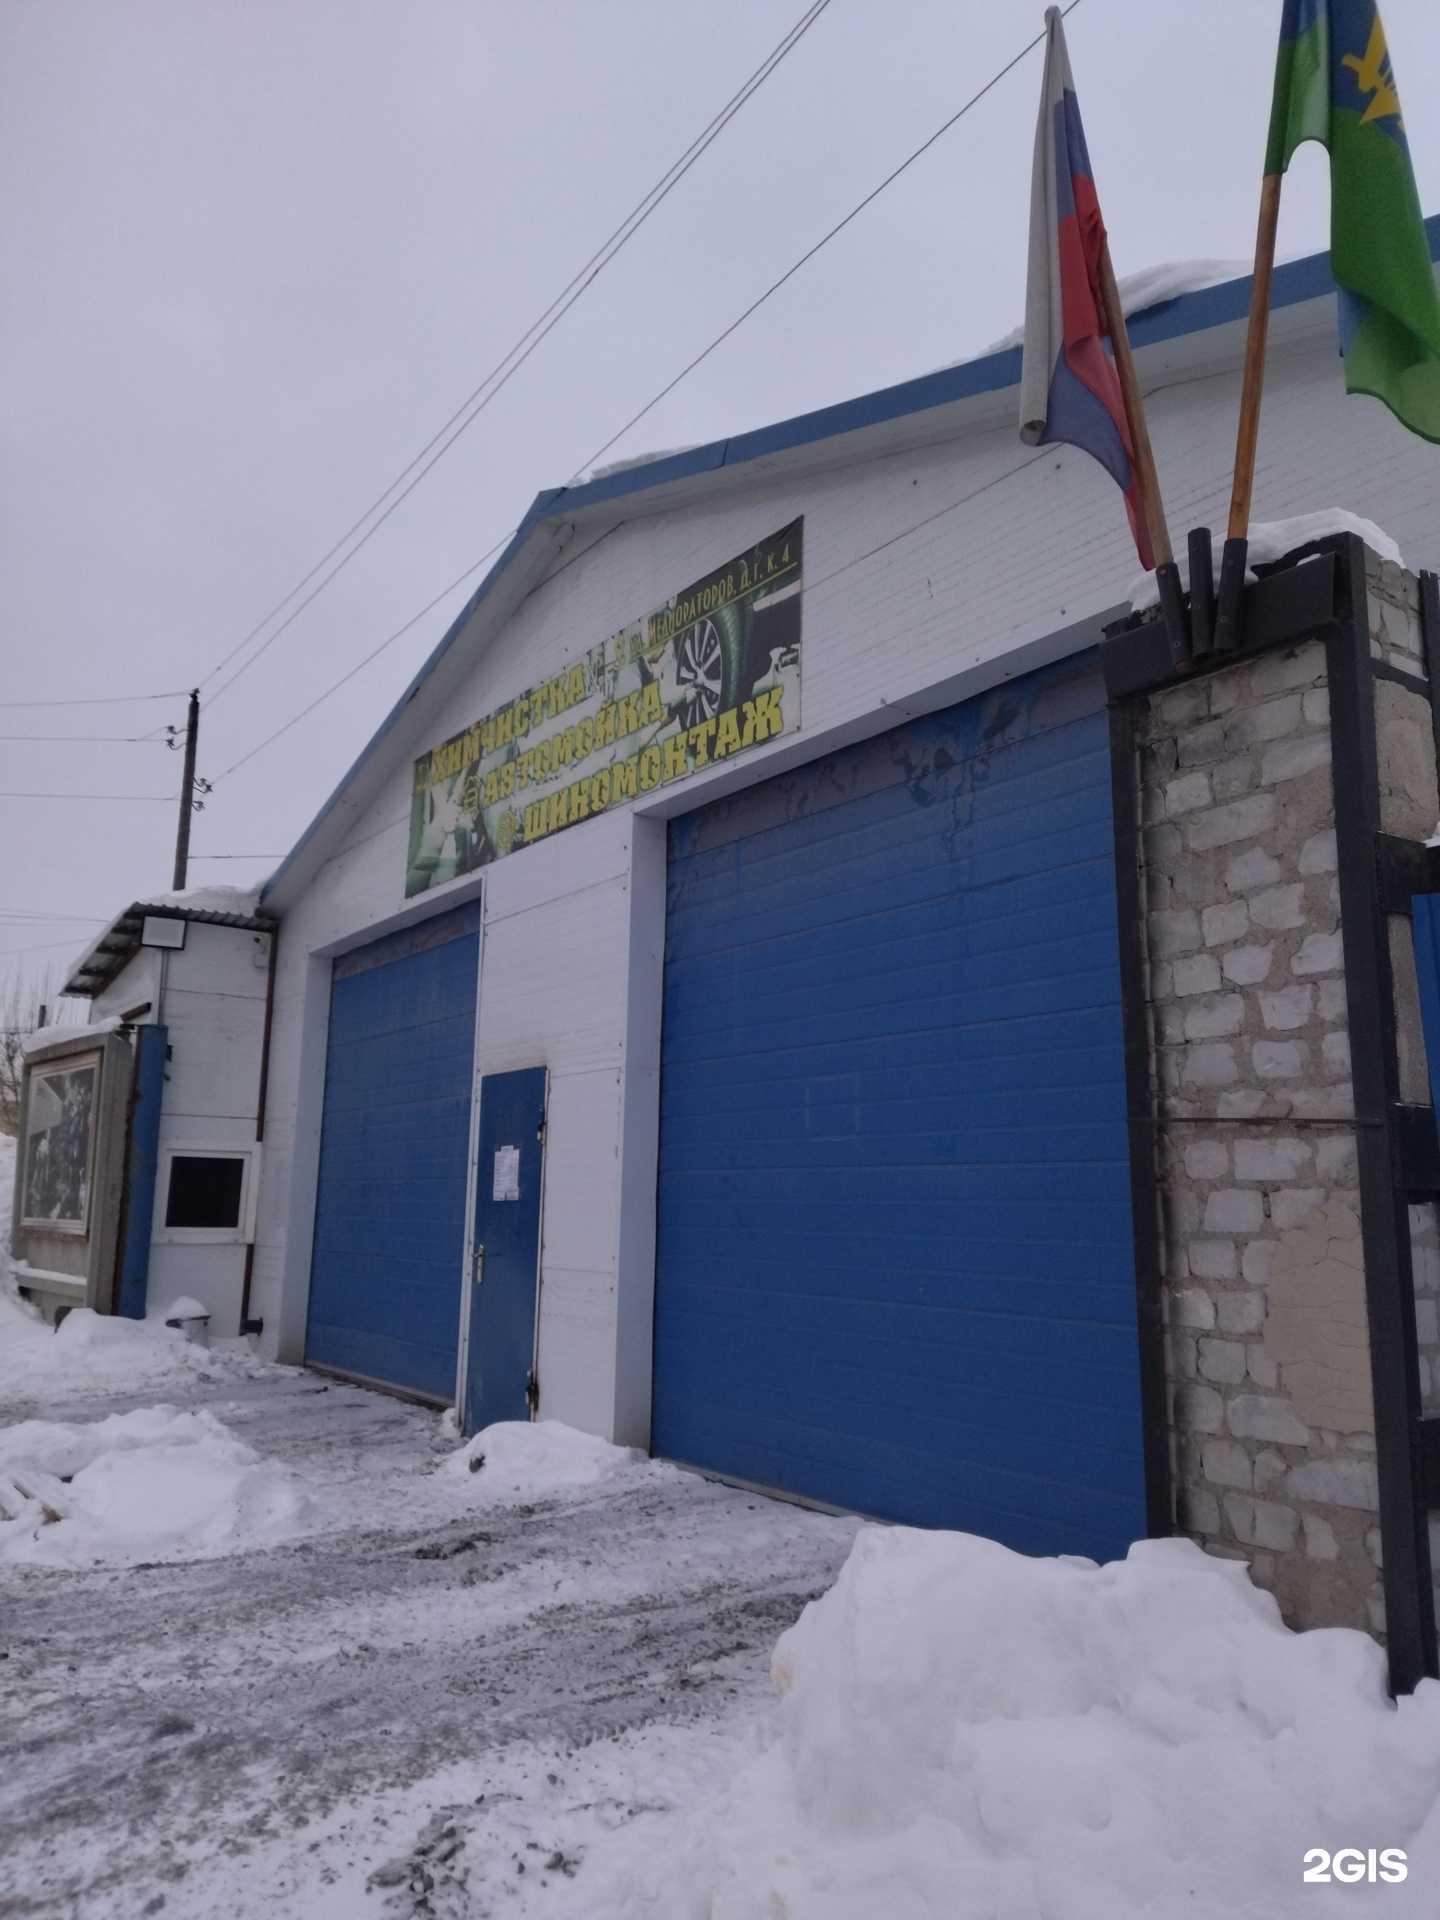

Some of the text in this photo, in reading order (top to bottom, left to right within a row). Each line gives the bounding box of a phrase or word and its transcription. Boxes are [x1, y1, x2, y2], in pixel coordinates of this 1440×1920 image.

[431, 662, 585, 784] ХИМЧИСТКА
[483, 678, 662, 808] АВТОМОЙКА
[523, 685, 784, 842] ШИНОМОНТАЖ
